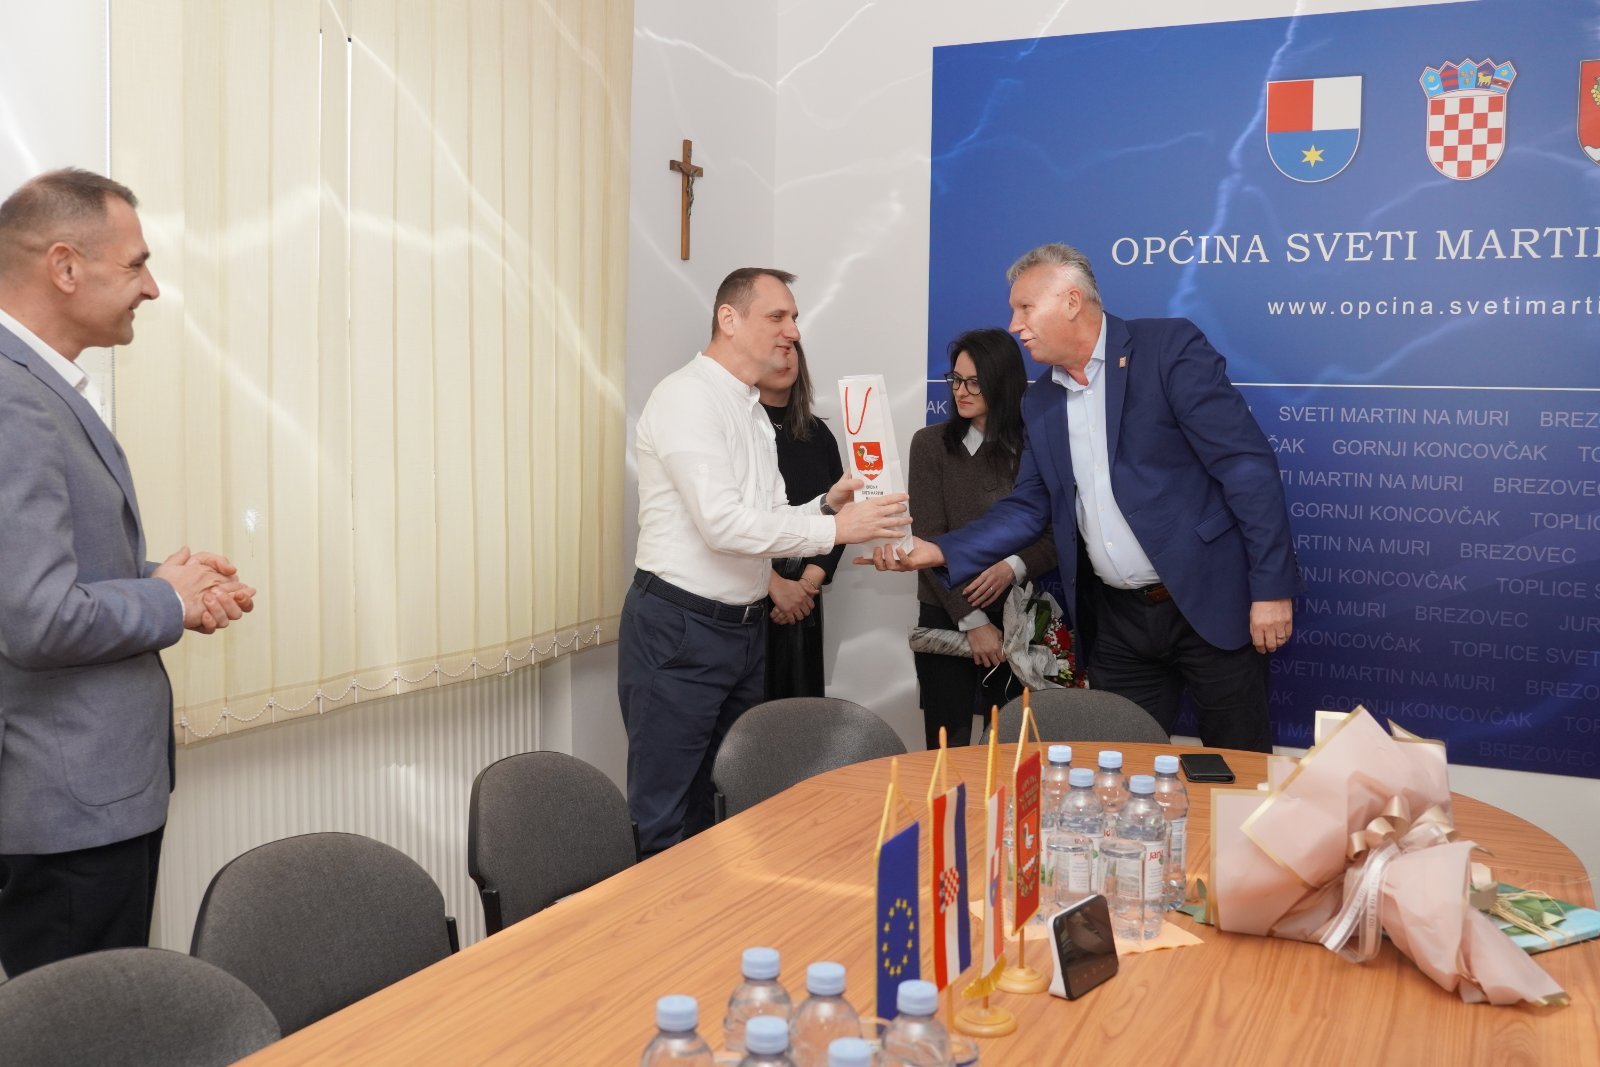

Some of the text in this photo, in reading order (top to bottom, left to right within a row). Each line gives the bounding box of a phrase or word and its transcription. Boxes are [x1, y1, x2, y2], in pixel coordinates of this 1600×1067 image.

[1111, 226, 1600, 266] OPĆINA SVETI MARTI
[1278, 405, 1600, 428] SVETI MARTIN NA MURI BREZ
[1332, 439, 1407, 457] GORNJI
[1413, 440, 1549, 462] KONCOVČAK
[1299, 471, 1373, 488] MARTIN
[1379, 472, 1407, 489] NA
[1411, 474, 1464, 492] MURI
[1493, 477, 1600, 497] BREZOVE
[1290, 501, 1363, 520] GORNJI
[1369, 504, 1501, 527] KONCOVČAK
[1347, 536, 1375, 553] NA
[1379, 538, 1431, 557] MURI
[1459, 542, 1577, 565] BREZOVEC
[1338, 568, 1468, 592] KONCOVČAK
[1496, 577, 1587, 598] TOPLICE
[1305, 598, 1332, 615] NA
[1336, 600, 1387, 618] MURI
[1415, 605, 1529, 628] BREZOVEC
[1296, 629, 1422, 654] KONCOVČAK
[1450, 640, 1539, 662] TOPLICE
[1269, 658, 1323, 678] SVETI
[1330, 663, 1404, 684] MARTIN
[1411, 670, 1438, 687] NA
[1443, 672, 1496, 692] MURI
[1479, 741, 1596, 767] BREZOVEC
